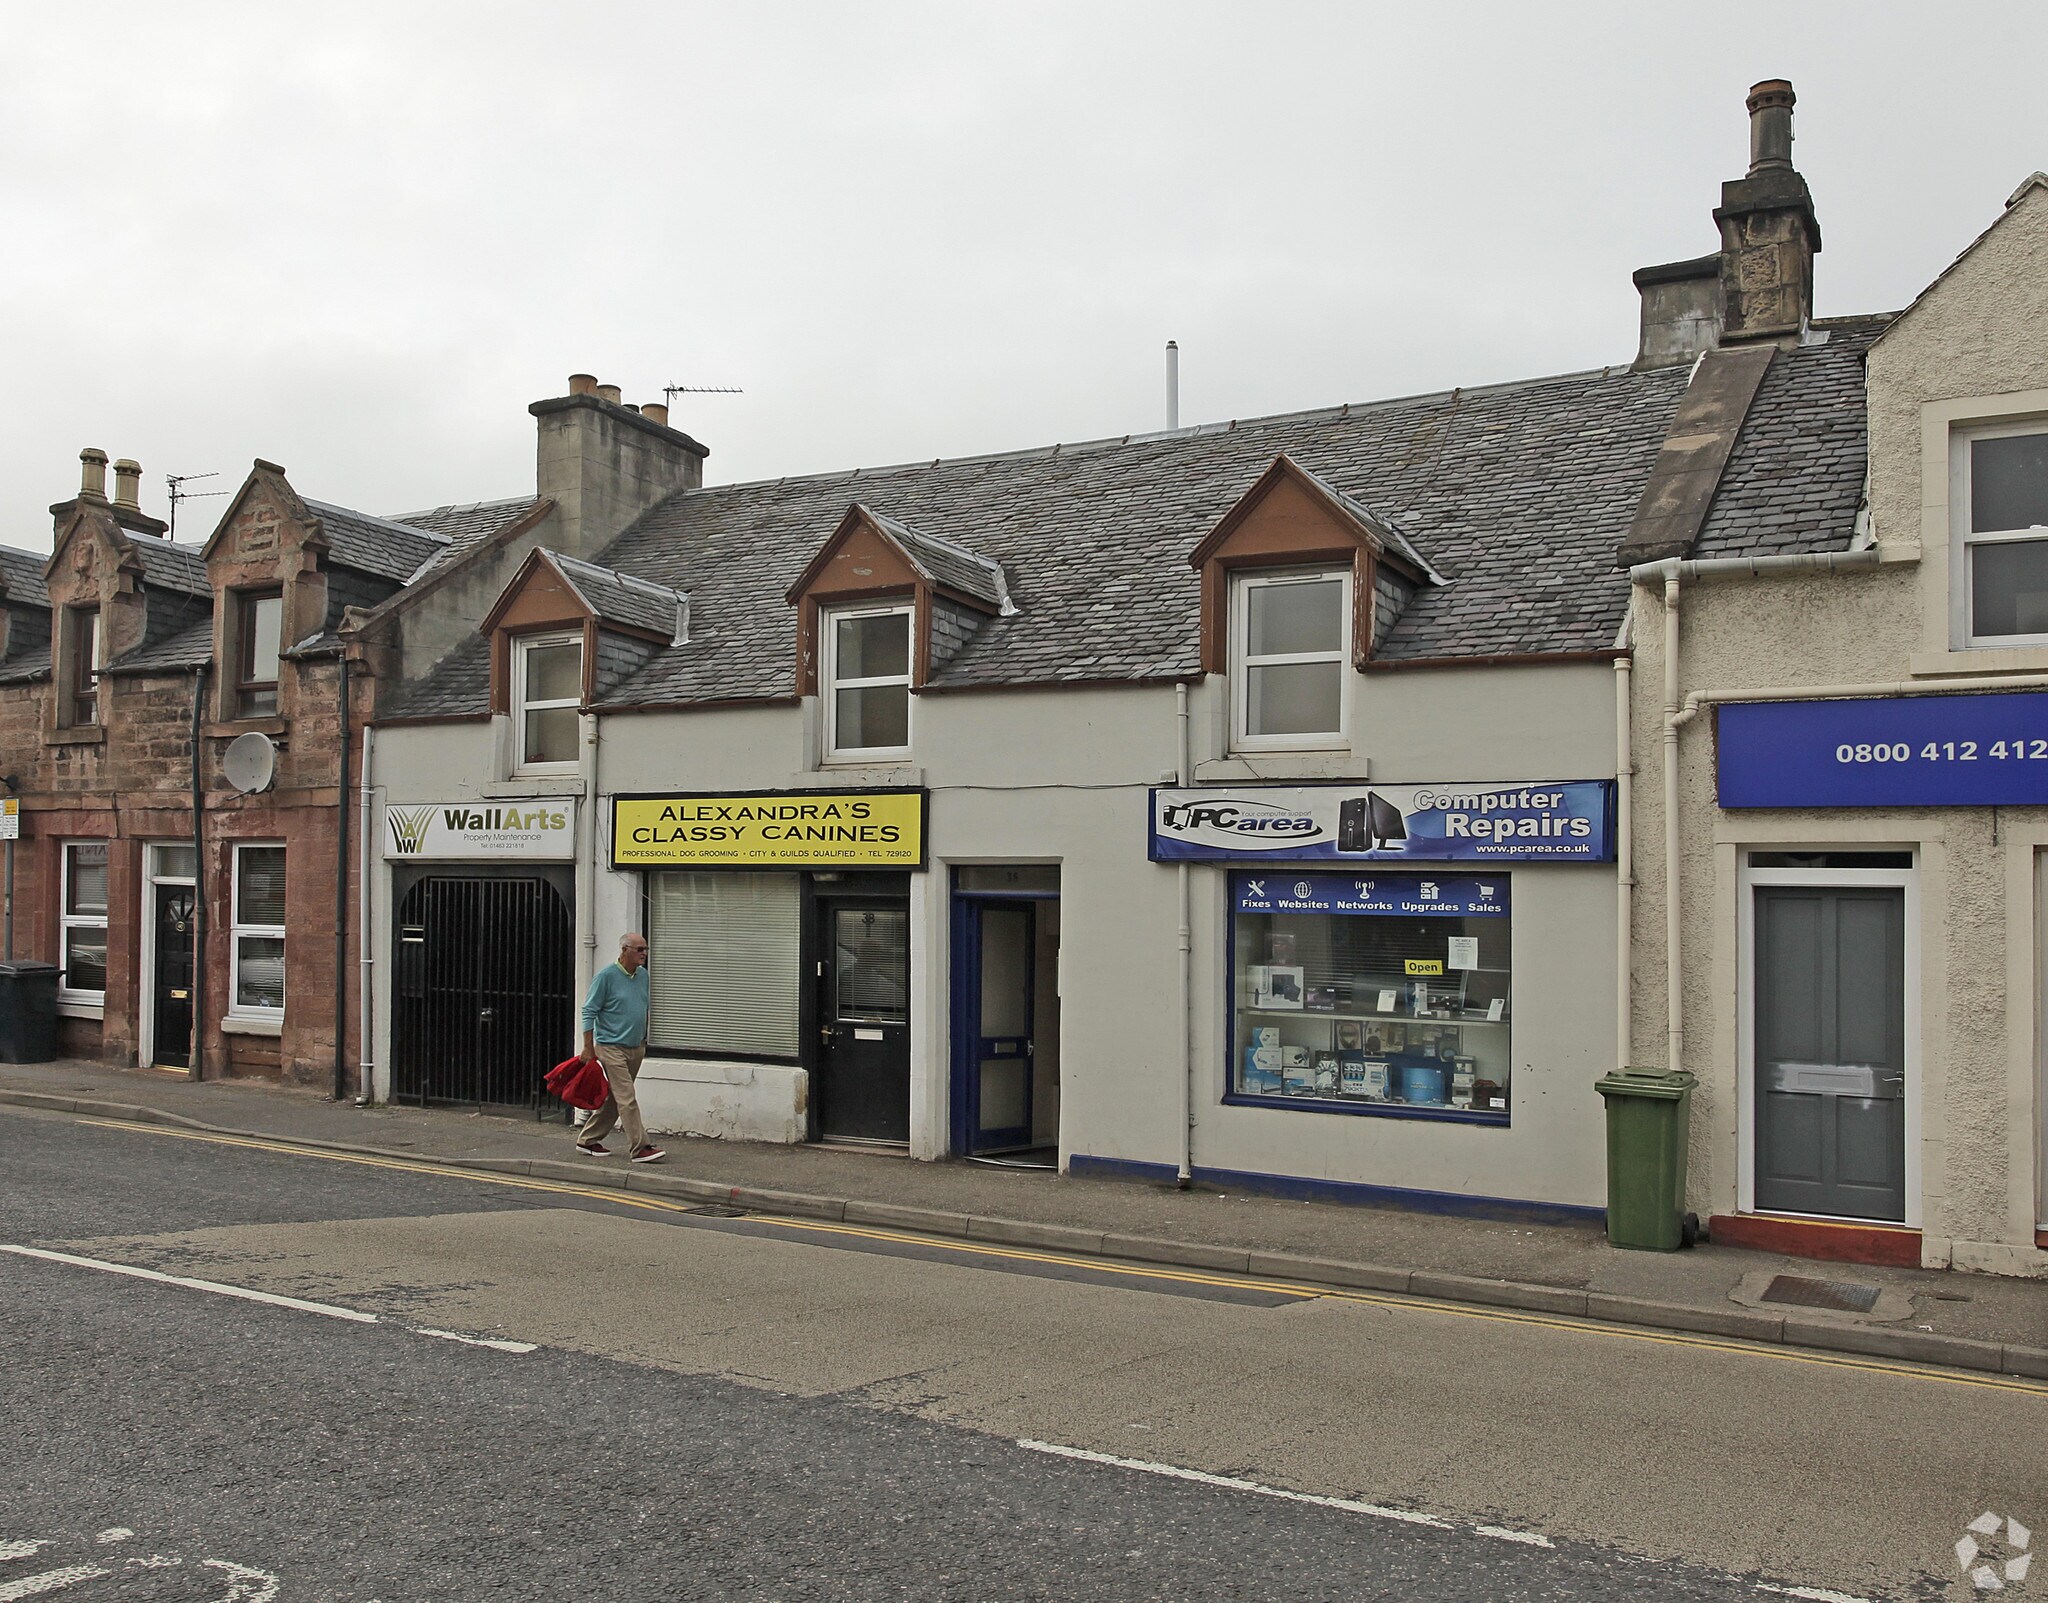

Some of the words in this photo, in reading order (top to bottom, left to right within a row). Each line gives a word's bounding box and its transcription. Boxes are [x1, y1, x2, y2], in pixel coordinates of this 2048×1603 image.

[1835, 743, 1910, 763] 0800
[1920, 741, 1978, 761] 412
[1988, 740, 2048, 760] 412
[1414, 789, 1563, 814] Computer
[659, 803, 871, 821] ALEXANDRA'S
[1288, 810, 1312, 818] support
[1445, 813, 1591, 843] Repairs
[464, 834, 491, 842] Property
[493, 833, 541, 841] Maintenance
[632, 826, 747, 844] CLASSY
[761, 825, 900, 842] CANINES
[813, 850, 855, 858] QUALIFIED
[1476, 844, 1590, 854] www.pcarea.co.uk
[1242, 899, 1271, 908] Fixes
[1278, 900, 1329, 909] Websites
[1337, 901, 1393, 910] Networks
[1401, 902, 1459, 912] Upgrades
[1468, 903, 1501, 912] Sales
[862, 913, 875, 923] 38
[1408, 962, 1438, 973] Open
